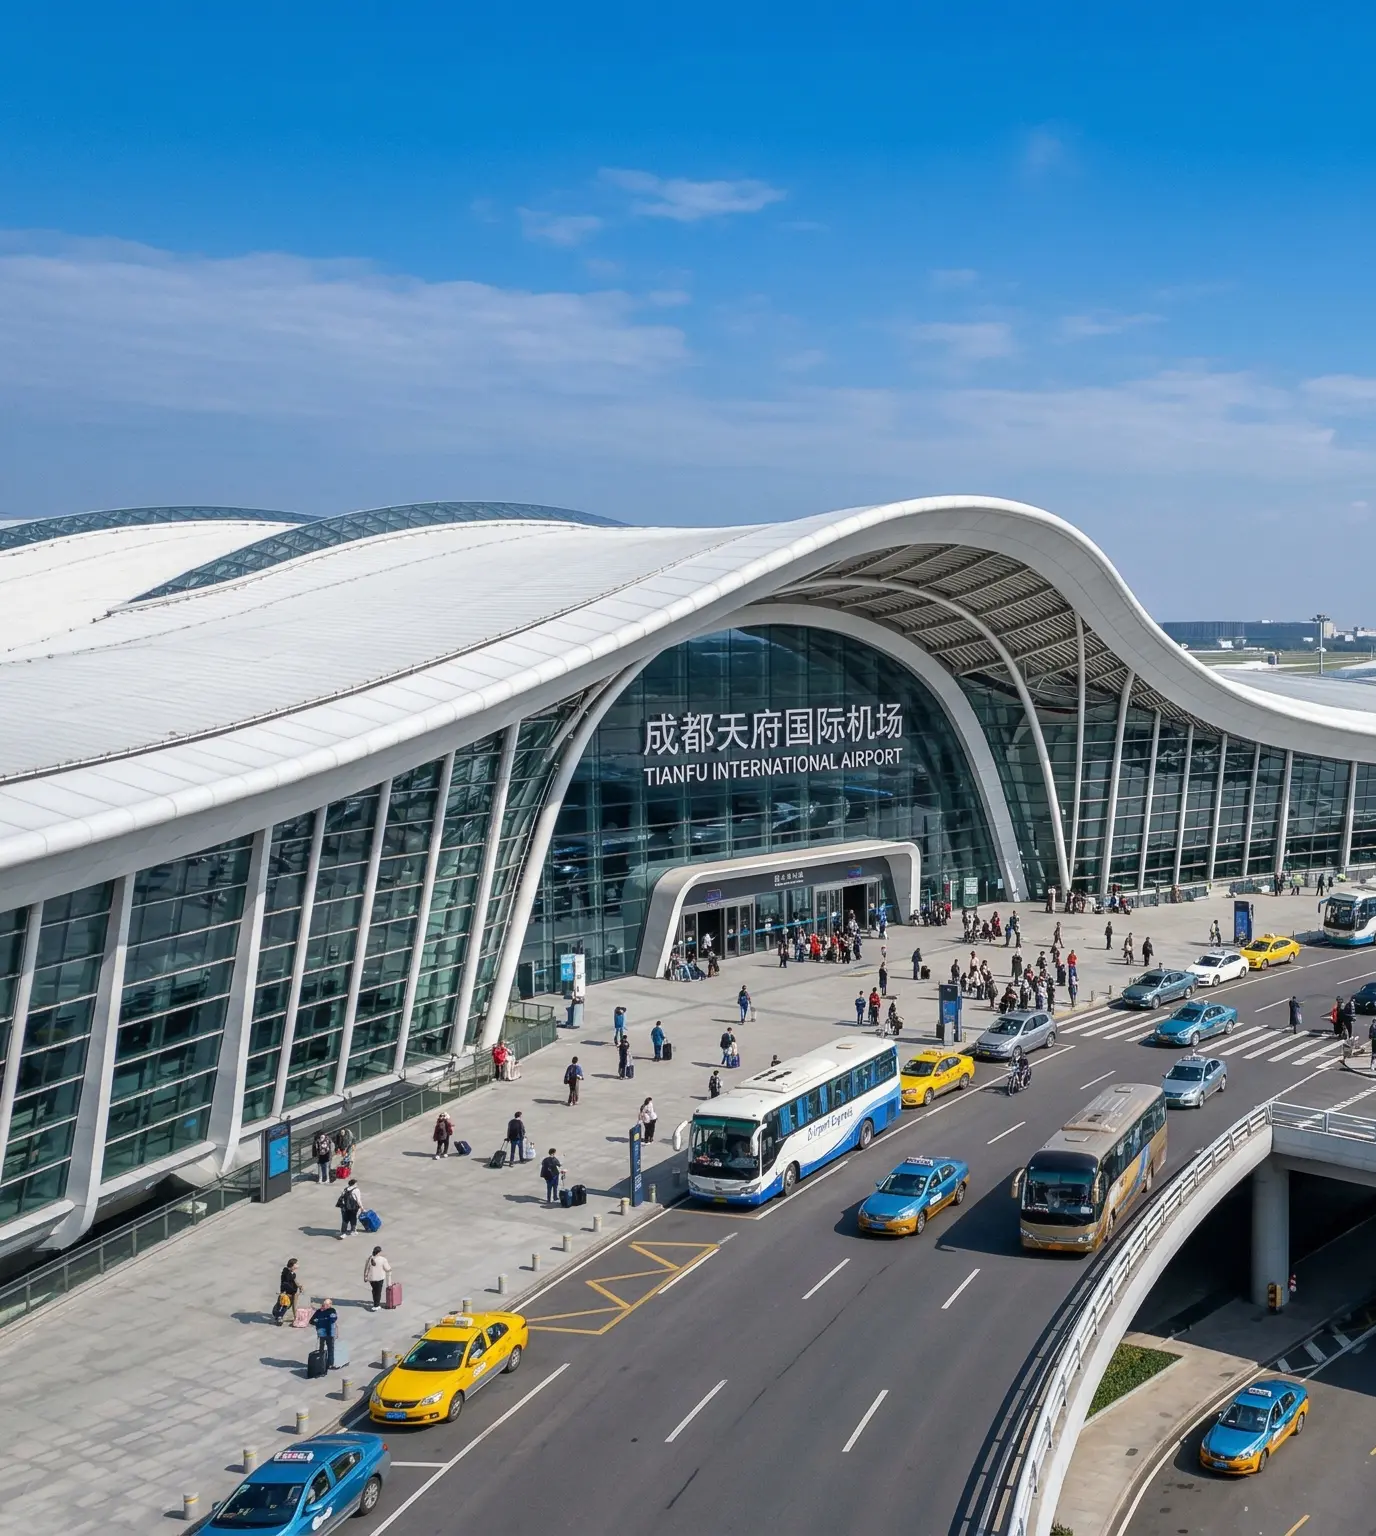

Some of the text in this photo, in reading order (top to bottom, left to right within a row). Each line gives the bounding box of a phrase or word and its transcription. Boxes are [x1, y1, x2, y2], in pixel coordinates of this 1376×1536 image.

[644, 703, 903, 756] 成都天府国际机场
[644, 748, 903, 786] TIANFU INTERNATIONAL AIRPORT
